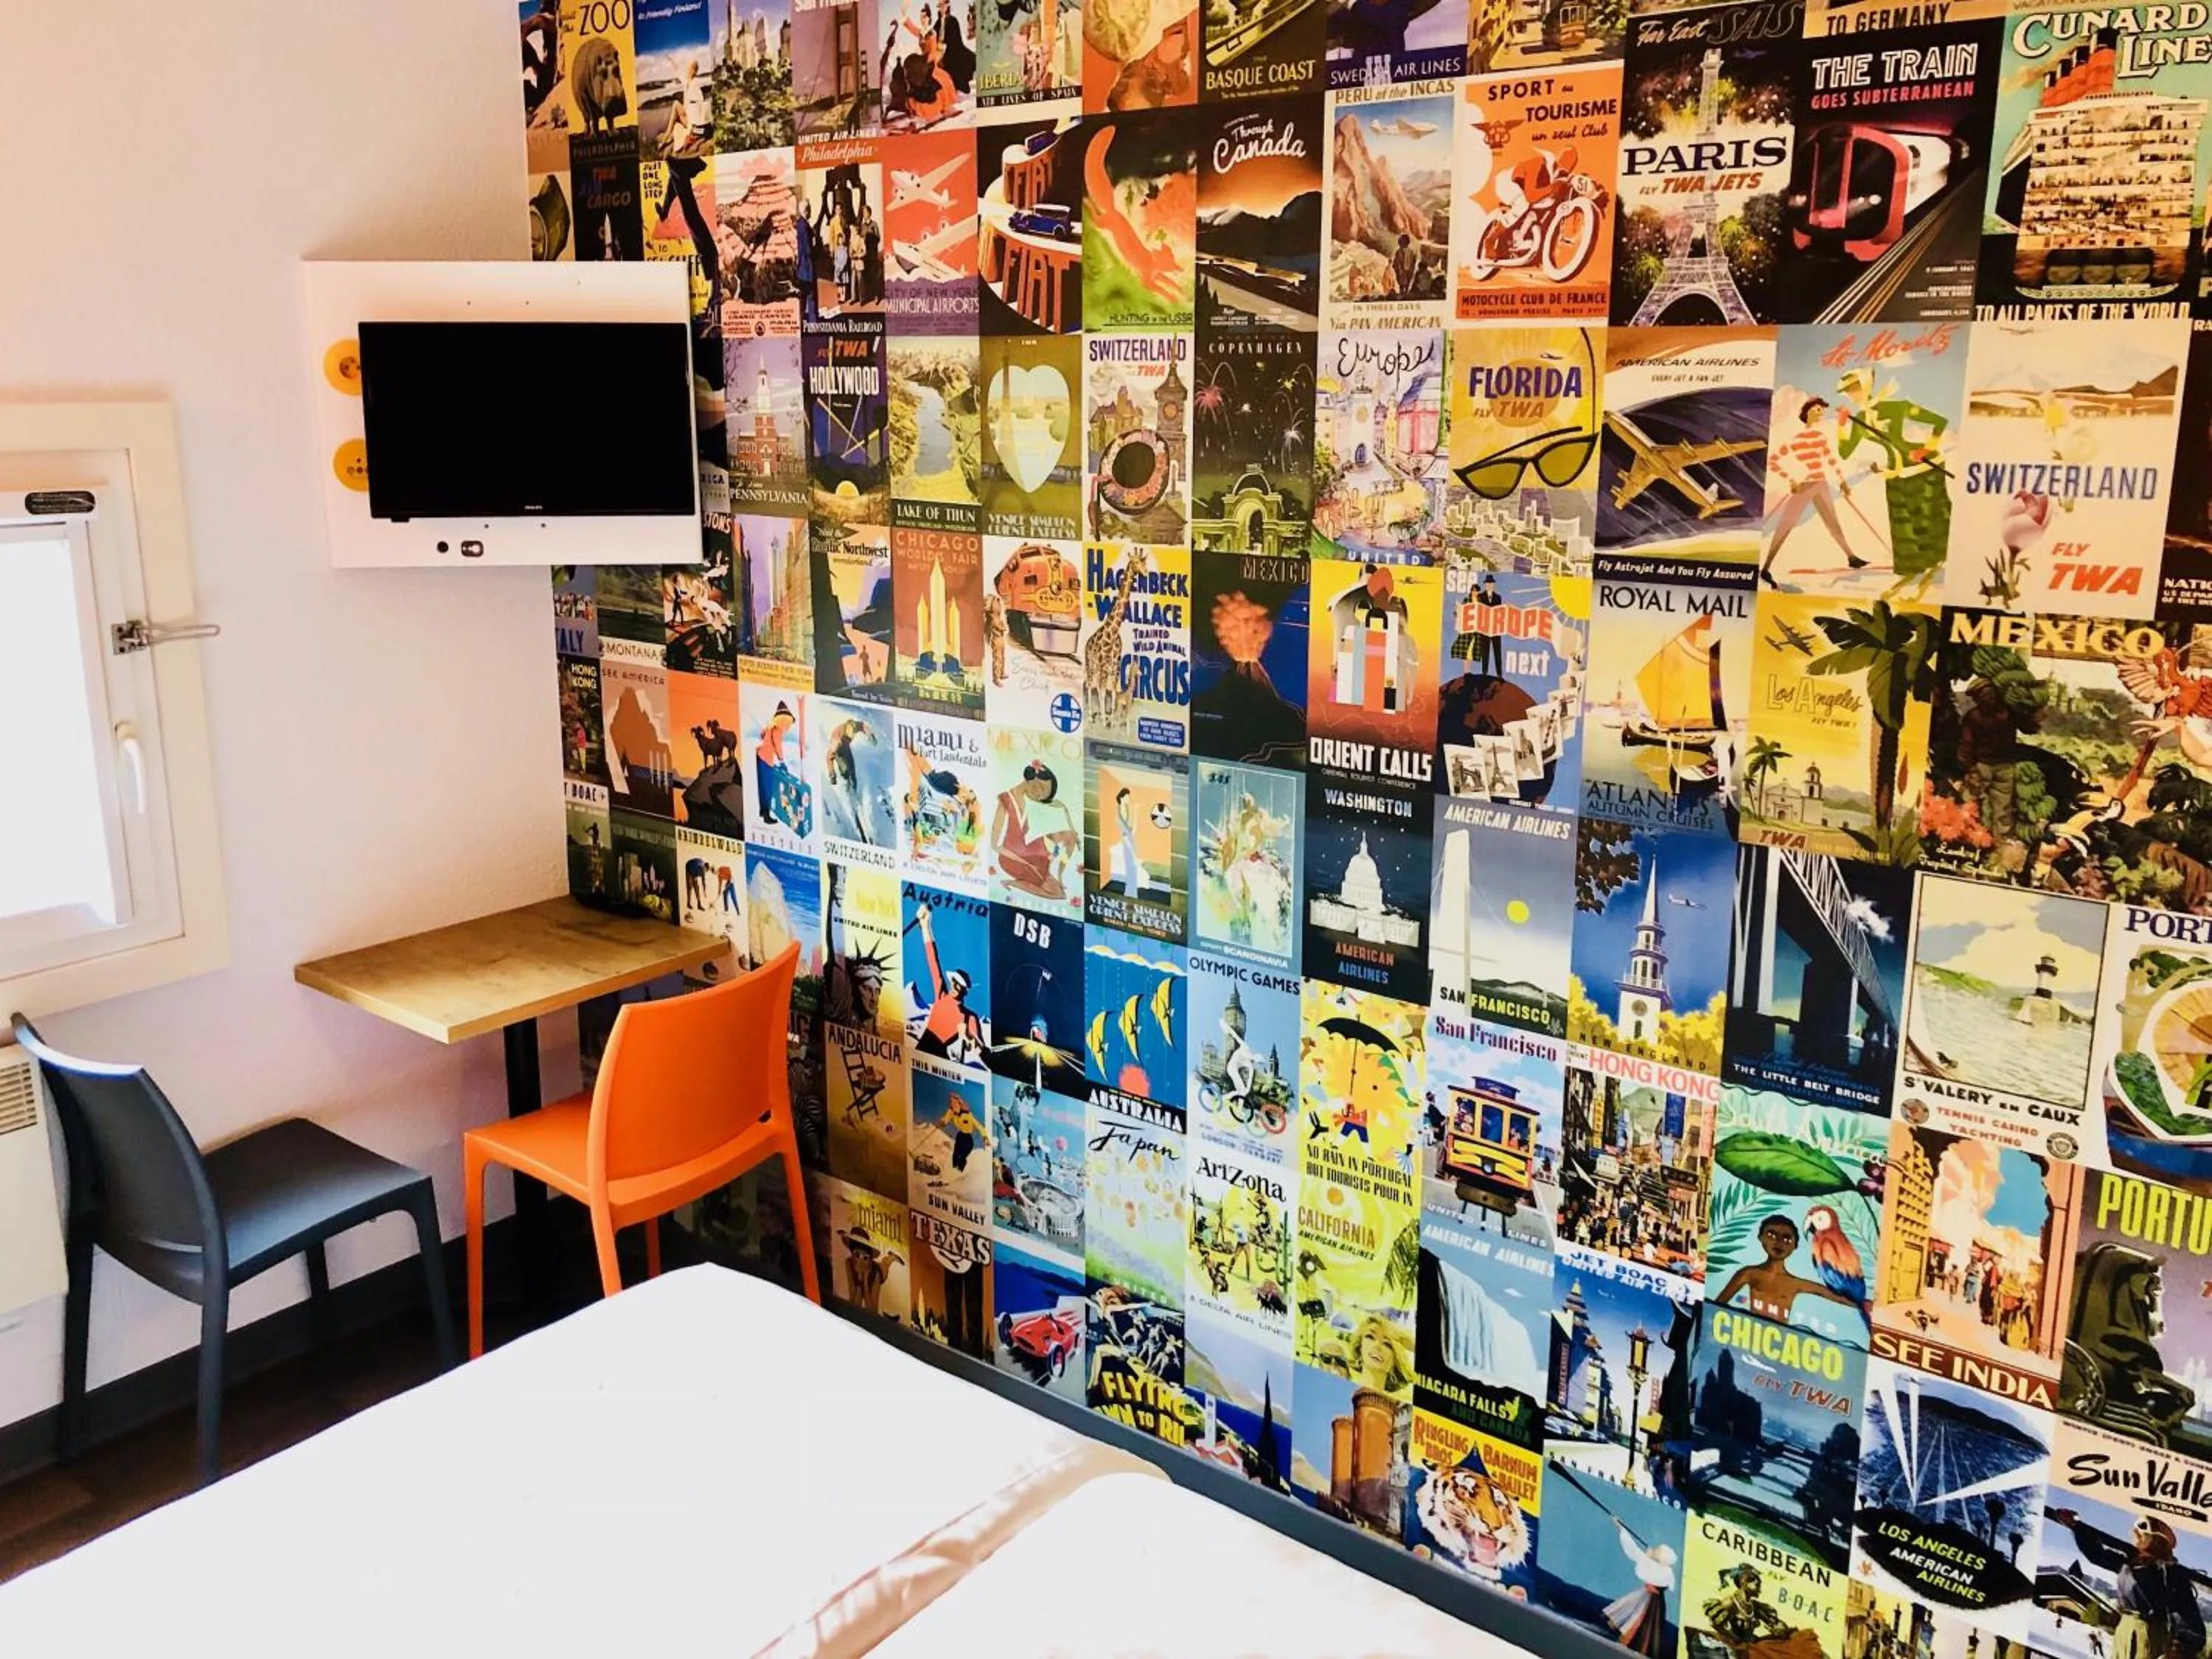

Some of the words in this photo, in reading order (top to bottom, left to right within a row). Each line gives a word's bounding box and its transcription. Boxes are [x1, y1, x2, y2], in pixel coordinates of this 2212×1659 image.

[580, 0, 630, 36] ZOO
[1827, 17, 1847, 35] TO
[1855, 7, 1949, 32] GERMANY
[2012, 3, 2211, 58] CUNARD
[1395, 63, 1416, 77] AIR
[1422, 58, 1461, 74] LINES
[1812, 55, 1873, 89] THE
[1881, 44, 1978, 83] TRAIN
[2118, 35, 2212, 78] LINE
[980, 72, 1024, 89] IBERIA
[1206, 66, 1262, 89] BASQUE
[1269, 60, 1316, 84] COAST
[1001, 94, 1026, 105] LINES
[1033, 91, 1045, 100] OF
[1051, 88, 1077, 99] SPAIN
[1335, 89, 1372, 103] PERU
[1411, 80, 1454, 95] INCAS
[1488, 79, 1554, 101] SPORT
[1811, 92, 1847, 110] GOES
[1853, 81, 1975, 105] SUBTERRANEAN
[1526, 100, 1617, 122] TOURISME
[799, 133, 830, 145] UNITED
[833, 131, 848, 140] AIR
[1231, 119, 1274, 142] Through
[801, 142, 873, 163] Philadelphia
[1213, 122, 1306, 175] Canada
[1621, 136, 1788, 175] PARIS
[1661, 176, 1706, 193] TWA
[1710, 172, 1764, 191] JETS
[588, 192, 630, 209] CARGO
[1002, 234, 1071, 335] FIAT
[886, 299, 931, 313] MUNICIPAL
[932, 297, 979, 313] AIRPORTS
[1520, 294, 1544, 305] CLUB
[1550, 293, 1561, 304] DE
[1568, 293, 1606, 304] FRANCE
[1976, 305, 1994, 321] TO
[1996, 305, 2020, 321] ALL
[2026, 305, 2072, 320] PARTS
[2078, 304, 2097, 319] OF
[2101, 304, 2129, 319] THE
[2132, 302, 2190, 319] WORLD
[1110, 315, 1150, 323] HUNTING
[835, 340, 868, 357] TWA
[1090, 339, 1186, 361] SWITZERLAND
[1209, 341, 1304, 353] COPENHAGEN
[1137, 366, 1165, 377] TWA
[1338, 338, 1435, 392] Europe
[1615, 358, 1691, 367] AMERICAN
[1695, 358, 1760, 366] AIRLINES
[810, 367, 879, 394] HOLLYWOOD
[1470, 366, 1582, 398] FLORIDA
[1498, 400, 1544, 418] TWA
[1966, 462, 2157, 499] SWITZERLAND
[731, 489, 807, 503] PENNSYLVANIA
[897, 504, 922, 518] LAKE
[926, 507, 940, 519] OF
[946, 508, 975, 522] THUN
[844, 542, 888, 557] Northwest
[897, 532, 978, 552] CHICAGO
[2052, 543, 2090, 556] FLY
[953, 552, 977, 564] FAIR
[1242, 557, 1309, 583] MEXICO
[1349, 552, 1421, 564] UNITED
[1598, 560, 1612, 571] Fly
[1658, 563, 1675, 574] And
[1677, 565, 1694, 577] You
[1697, 566, 1711, 579] Fly
[1714, 567, 1753, 580] Assured
[2048, 563, 2143, 594] TWA
[1599, 586, 1675, 612] ROYAL
[1687, 591, 1748, 618] MAIL
[1133, 629, 1169, 639] TRAINED
[1462, 603, 1553, 639] EUROPE
[1950, 612, 2164, 657] MEXICO
[605, 642, 658, 661] MONTANA
[1133, 642, 1155, 653] WILD
[1156, 641, 1186, 656] ANIMAL
[571, 664, 597, 676] HONG
[1506, 651, 1550, 676] next
[572, 678, 597, 689] KONG
[1120, 654, 1190, 705] CIRCUS
[1767, 674, 1794, 709] Los
[1795, 677, 1863, 713] Angeles
[970, 739, 978, 751] &
[1310, 737, 1375, 771] ORIENT
[1380, 748, 1433, 782] CALLS
[572, 785, 597, 801] BOAC
[1325, 790, 1413, 818] WASHINGTON
[1444, 803, 1509, 829] AMERICAN
[1513, 816, 1571, 840] AIRLINES
[1588, 799, 1649, 818] AUTUMN
[1657, 811, 1714, 830] CRUISES
[1757, 830, 1807, 848] TWA
[824, 841, 895, 869] SWITZERLAND
[902, 882, 989, 917] Austria
[1013, 913, 1050, 949] DSB
[1335, 942, 1394, 965] AMERICAN
[1189, 956, 1248, 981] OLYMPIC
[1252, 971, 1300, 995] GAMES
[1338, 961, 1389, 984] AIRLINES
[1440, 986, 1465, 1004] SAN
[1470, 993, 1550, 1025] FRANCISCO
[828, 1024, 902, 1064] ANDALUCIA
[1436, 1015, 1465, 1040] San
[1470, 1024, 1557, 1062] Francisco
[1579, 1033, 1611, 1047] NEW
[1627, 1044, 1705, 1071] ENGLAND
[931, 1062, 961, 1080] WINTER
[1590, 1048, 1652, 1082] HONG
[1657, 1066, 1720, 1102] KONG
[1733, 1063, 1756, 1077] THE
[1762, 1071, 1797, 1085] LITTLE
[1804, 1080, 1830, 1093] BELT
[1836, 1087, 1881, 1105] BRIDGE
[1089, 1088, 1183, 1132] AUSTRALIA
[1923, 1079, 1993, 1105] VALERY
[2028, 1105, 2081, 1127] CAUX
[1936, 1107, 1985, 1124] TENNIS
[1992, 1119, 2039, 1136] CASINO
[1949, 1123, 2023, 1147] YACHTING
[1088, 1121, 1180, 1161] Japan
[1307, 1143, 1319, 1159] NO
[1349, 1156, 1358, 1171] IN
[1362, 1157, 1412, 1188] PORTUGAL
[1373, 1185, 1399, 1202] POUR
[1403, 1192, 1413, 1206] IN
[928, 1195, 947, 1211] SUN
[953, 1203, 984, 1225] VALLEY
[910, 1209, 991, 1266] TEXAS
[1298, 1206, 1375, 1248] CALIFORNIA
[1424, 1225, 1492, 1256] AMERICAN
[1299, 1230, 1338, 1249] AMERICAN
[1340, 1241, 1374, 1260] AIRLINES
[1571, 1252, 1605, 1267] JET
[1615, 1265, 1666, 1287] BOAC
[1235, 1313, 1255, 1326] AIR
[1713, 1310, 1843, 1381] CHICAGO
[1872, 1332, 1947, 1373] SEE
[1952, 1357, 2055, 1411] INDIA
[1469, 1393, 1508, 1418] FALLS
[1790, 1380, 1853, 1416] TWA
[1137, 1411, 1153, 1427] TO
[1414, 1415, 1469, 1454] RINGLING
[1483, 1442, 1538, 1483] BARNUM
[2067, 1453, 2140, 1488] Sun
[2155, 1503, 2192, 1516] IDAHO
[1702, 1522, 1831, 1587] CARIBBEAN
[1877, 1521, 1912, 1542] LOS
[1915, 1534, 1987, 1572] ANGELES
[1890, 1546, 1974, 1585] AMERICAN
[1916, 1570, 1986, 1602] AIRLINES
